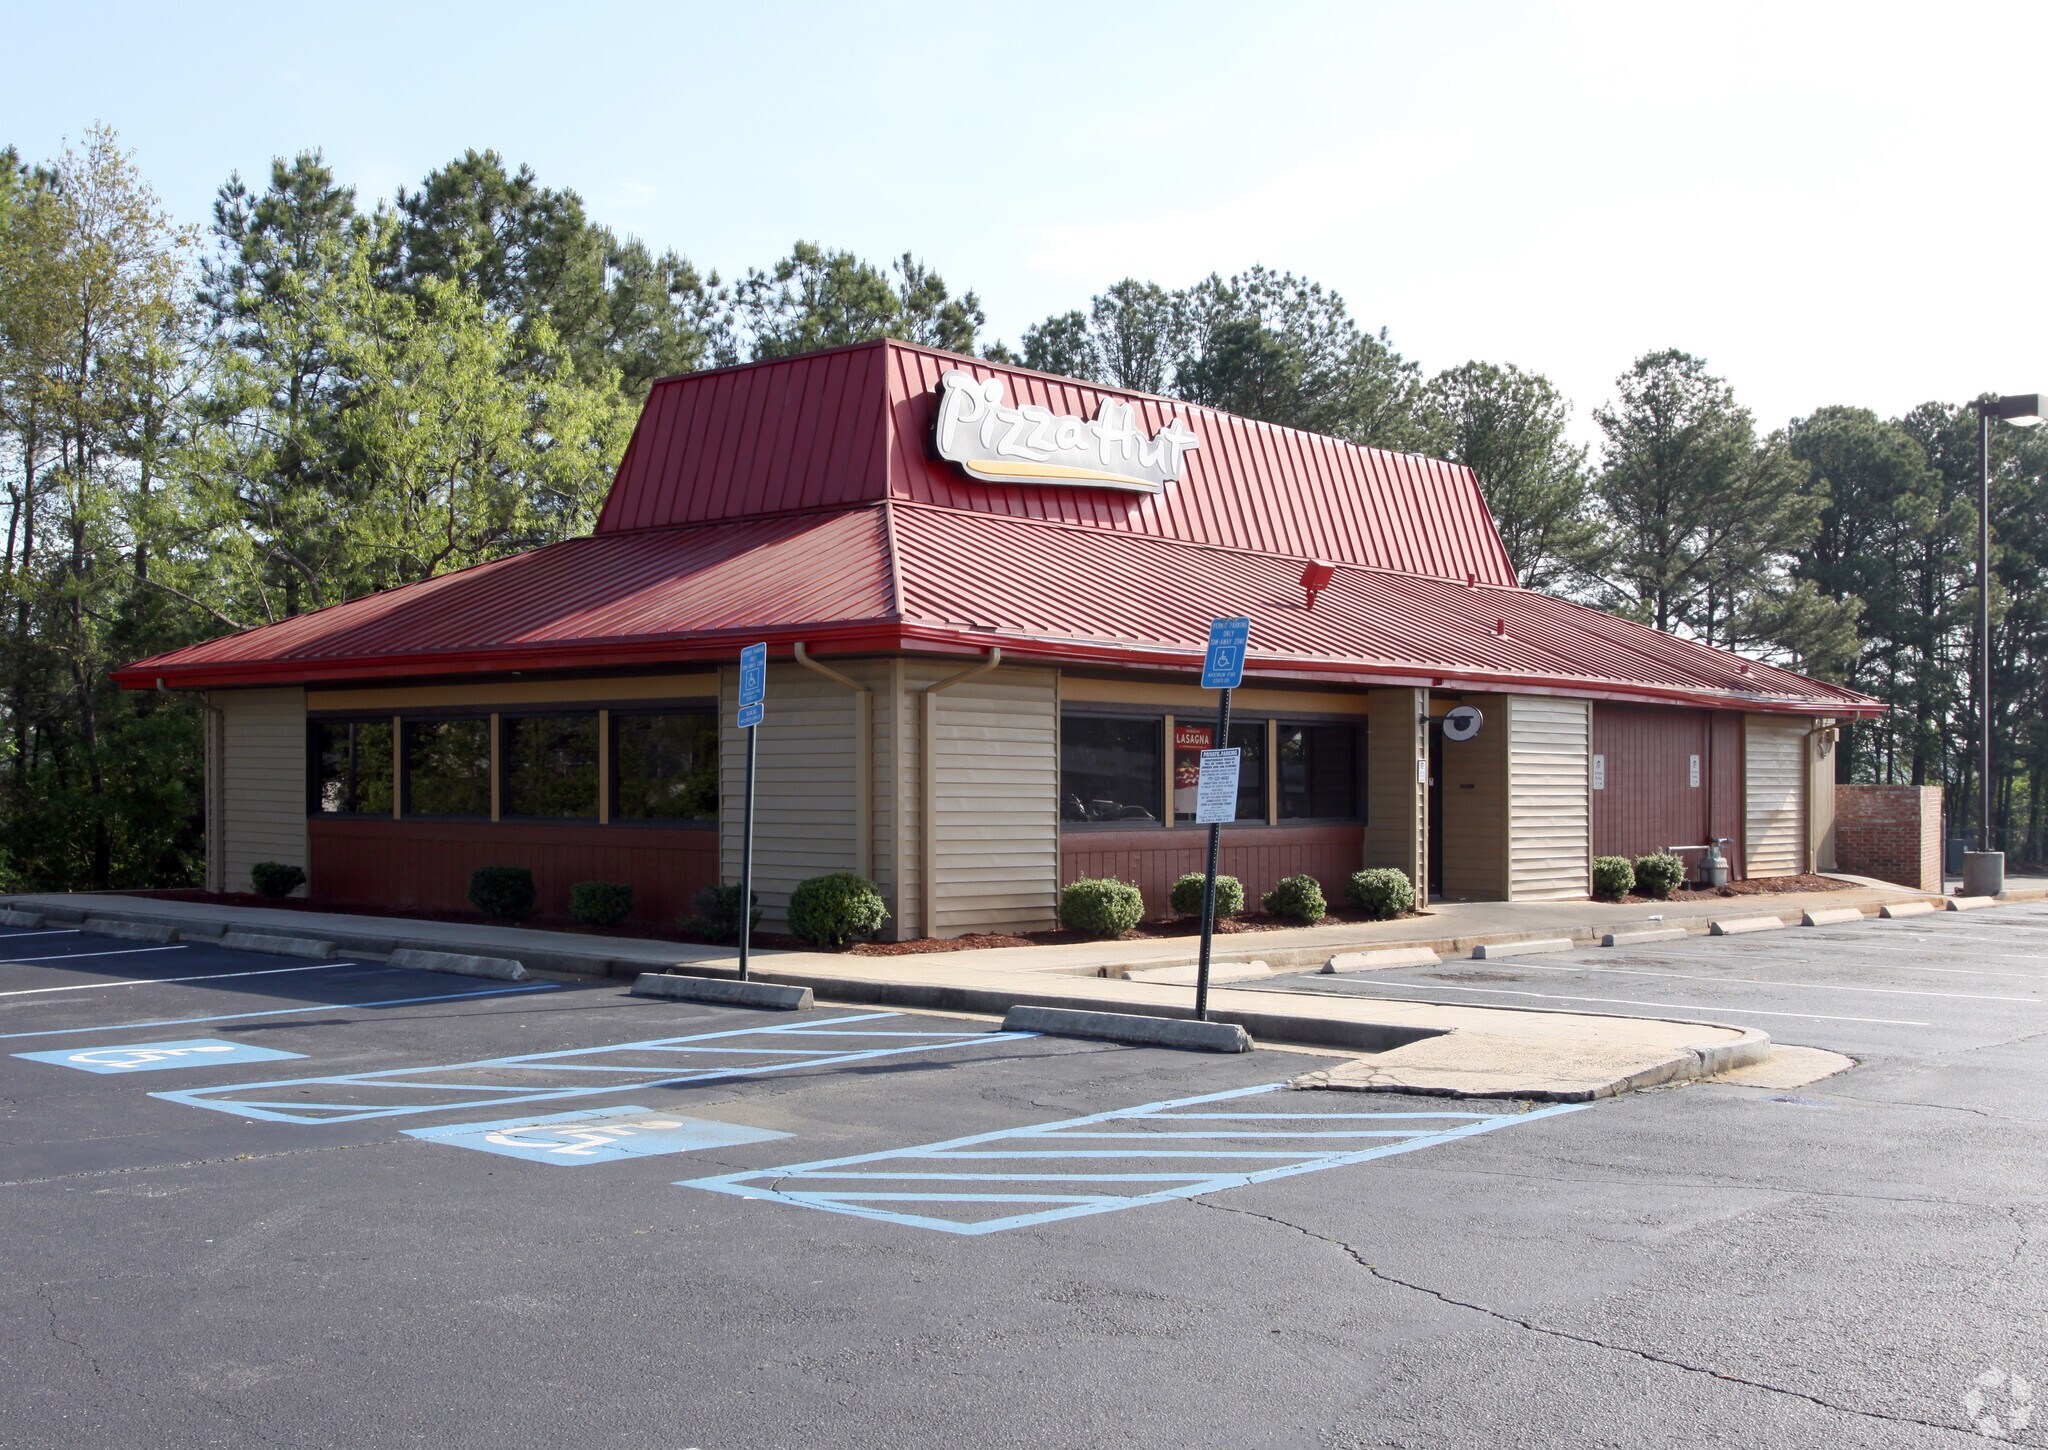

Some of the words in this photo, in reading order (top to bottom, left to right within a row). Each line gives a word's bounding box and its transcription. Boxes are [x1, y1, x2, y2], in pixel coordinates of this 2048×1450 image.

[942, 375, 1088, 462] Pizza
[1091, 397, 1198, 475] Hut
[746, 709, 757, 717] VAN
[1176, 734, 1209, 745] LASAGNA
